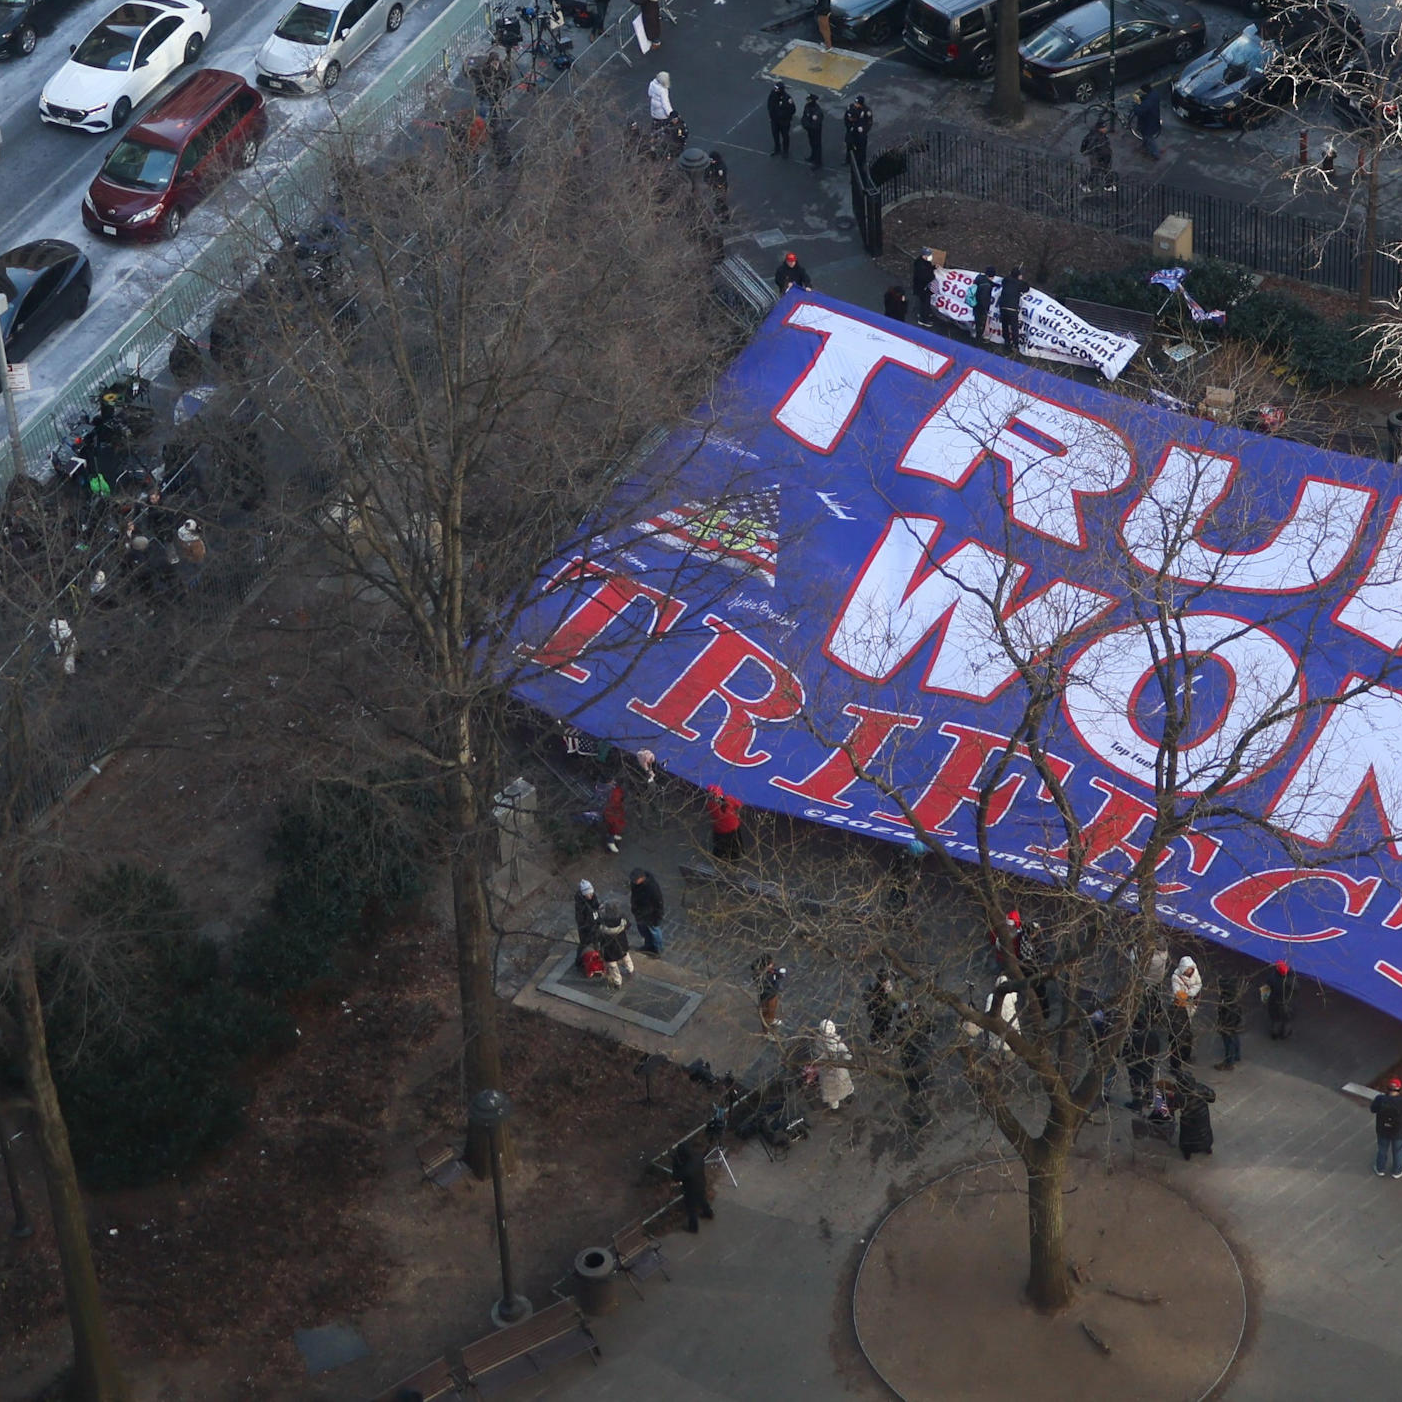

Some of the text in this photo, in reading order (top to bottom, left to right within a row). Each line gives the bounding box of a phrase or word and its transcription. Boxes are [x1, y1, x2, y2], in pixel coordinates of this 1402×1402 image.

[935, 295, 970, 318] Stop
[942, 280, 967, 300] Sto
[1038, 315, 1077, 341] witch
[1080, 338, 1117, 363] hunt
[1045, 303, 1128, 353] conspiracy
[1109, 740, 1156, 770] Top Fuel
